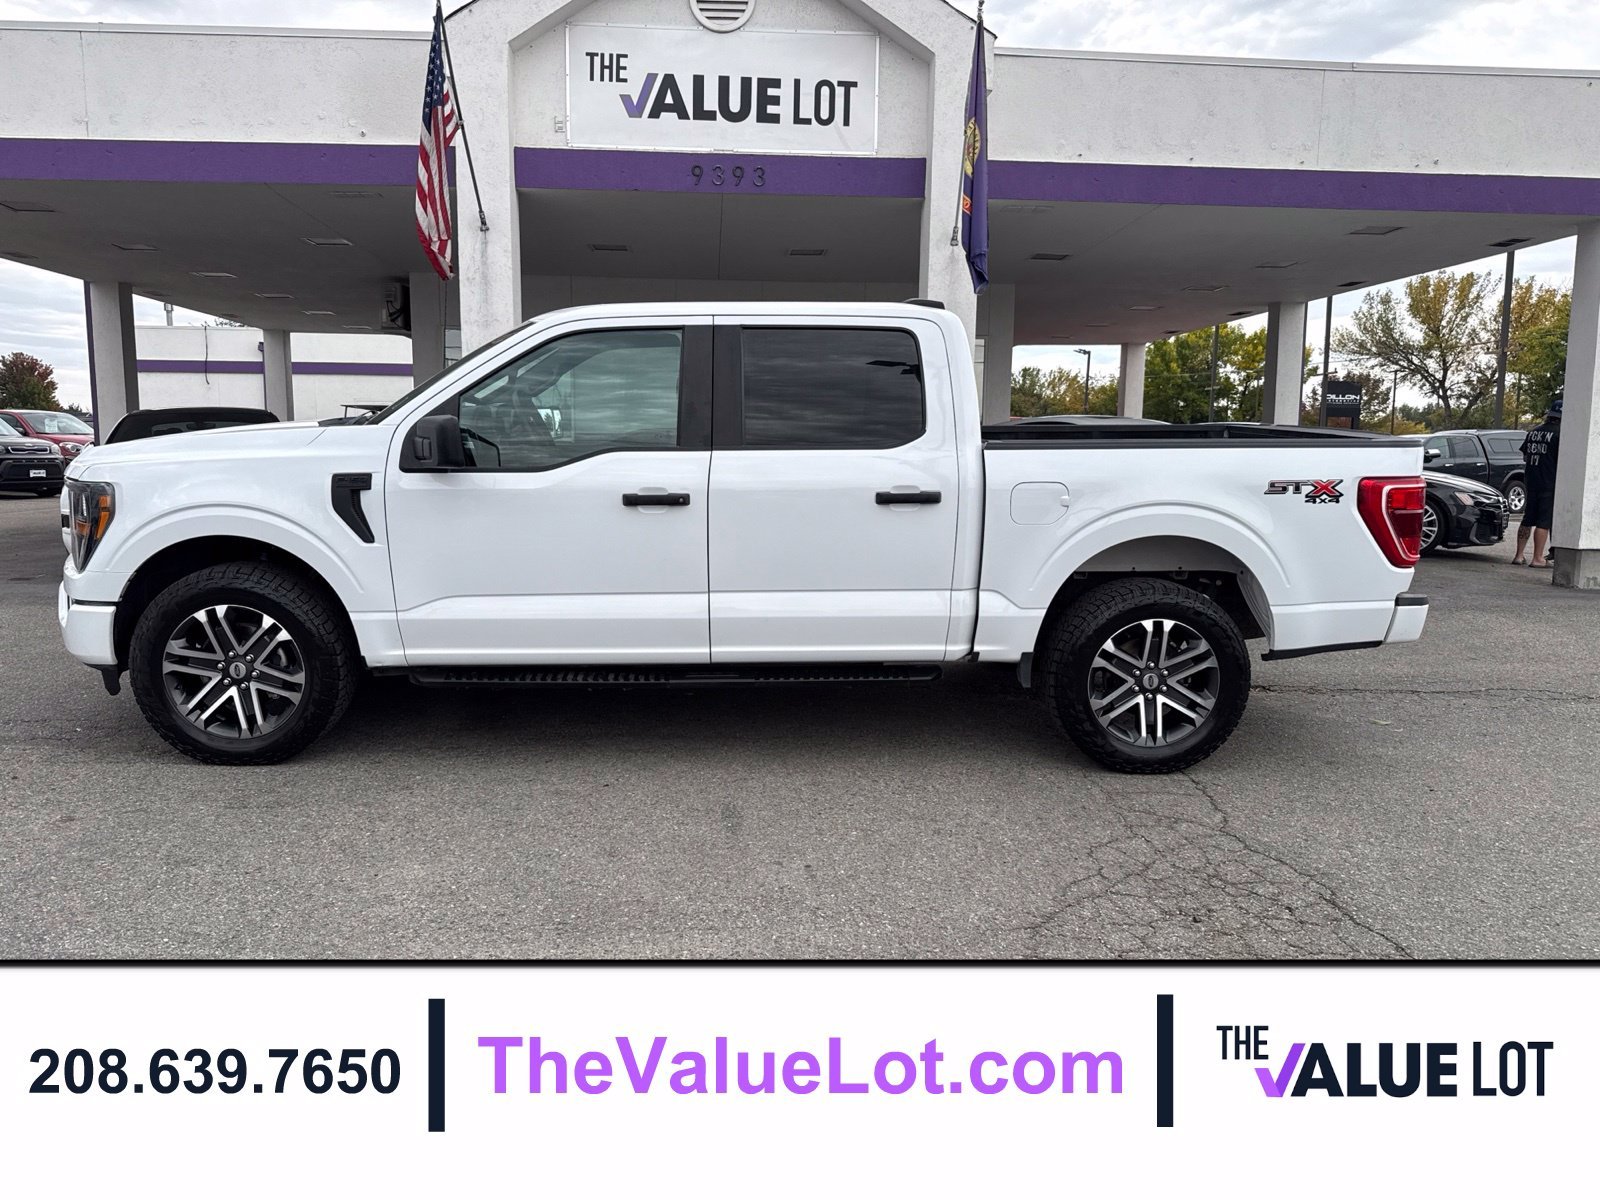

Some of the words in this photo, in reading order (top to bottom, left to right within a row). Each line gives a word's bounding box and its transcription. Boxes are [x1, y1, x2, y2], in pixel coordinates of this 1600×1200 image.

[585, 51, 629, 83] THE
[619, 72, 782, 125] VALUE
[792, 77, 858, 127] LOT
[690, 164, 767, 187] 9393
[1263, 479, 1344, 499] STX
